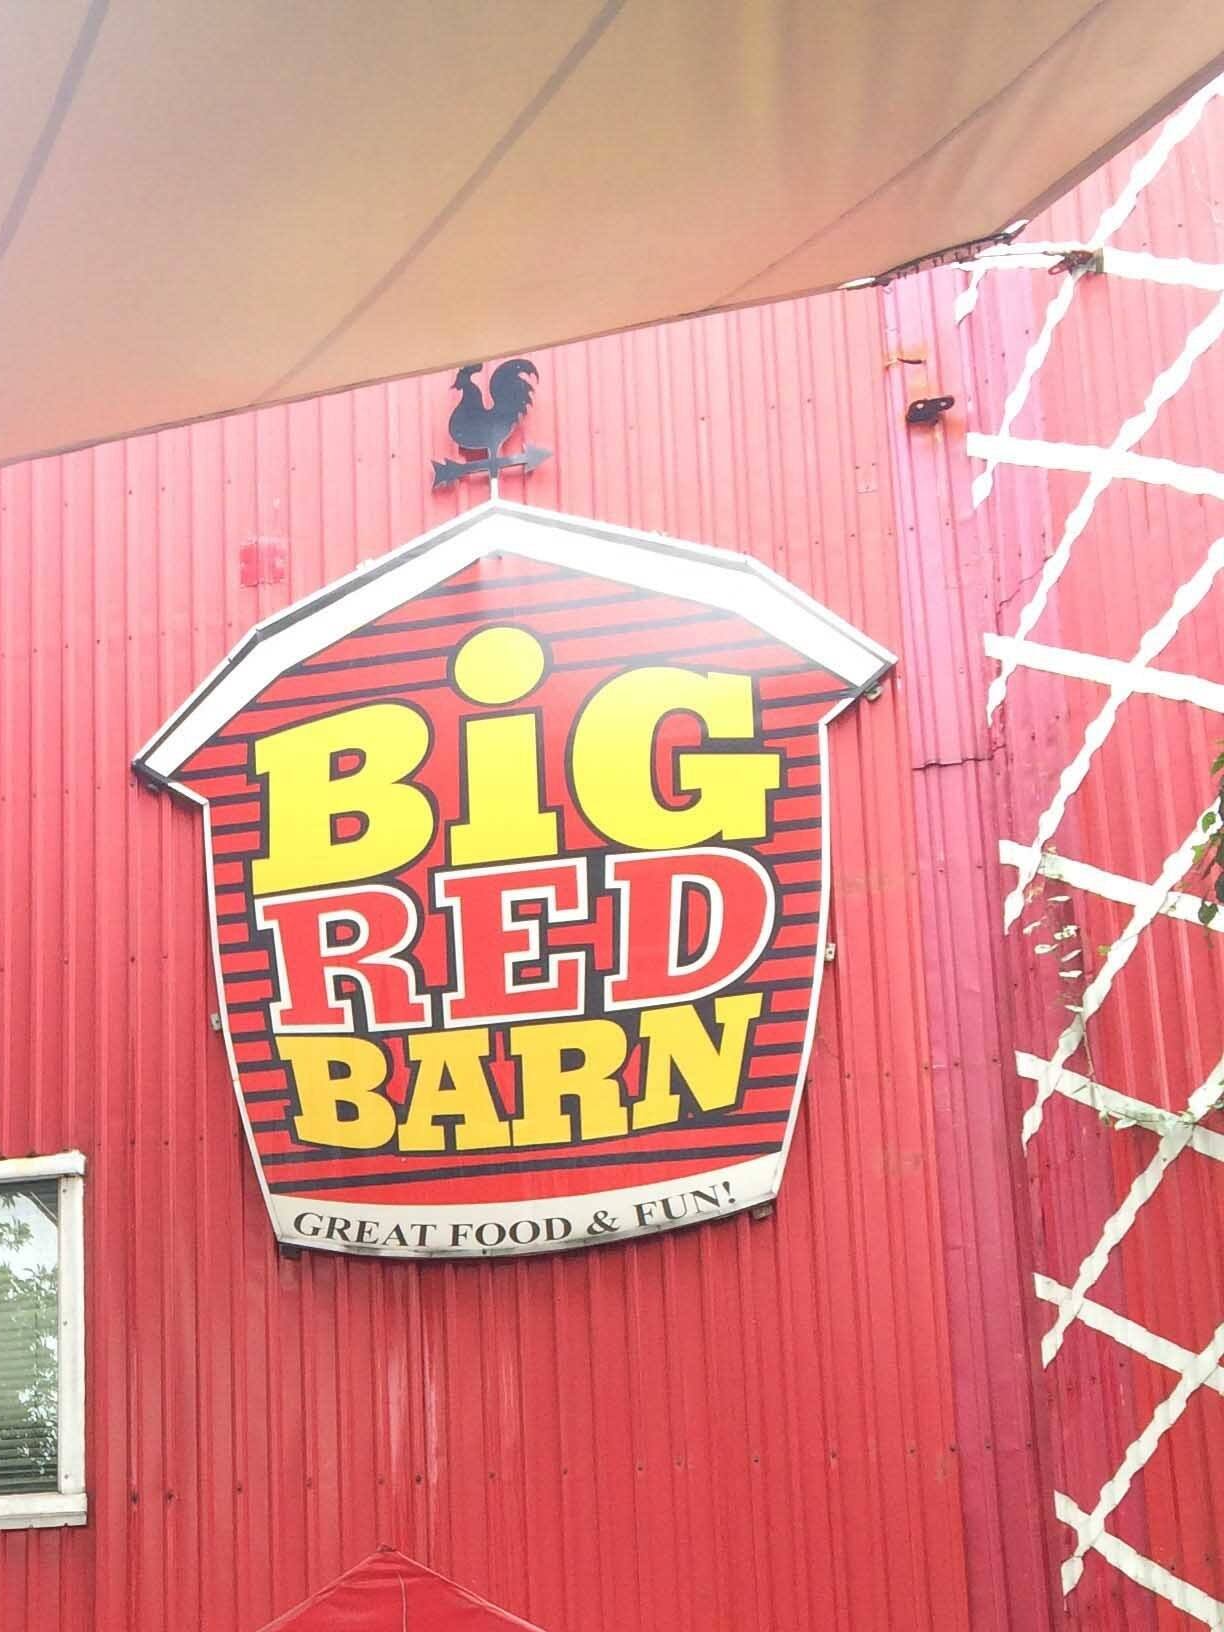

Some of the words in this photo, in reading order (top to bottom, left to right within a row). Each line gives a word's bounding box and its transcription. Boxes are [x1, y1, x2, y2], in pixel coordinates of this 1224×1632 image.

[254, 845, 776, 1034] RED
[274, 990, 764, 1153] BARN
[292, 1211, 437, 1249] GREAT
[448, 1214, 573, 1249] FOOD
[586, 1208, 622, 1237] &
[634, 1179, 736, 1230] FUN!
